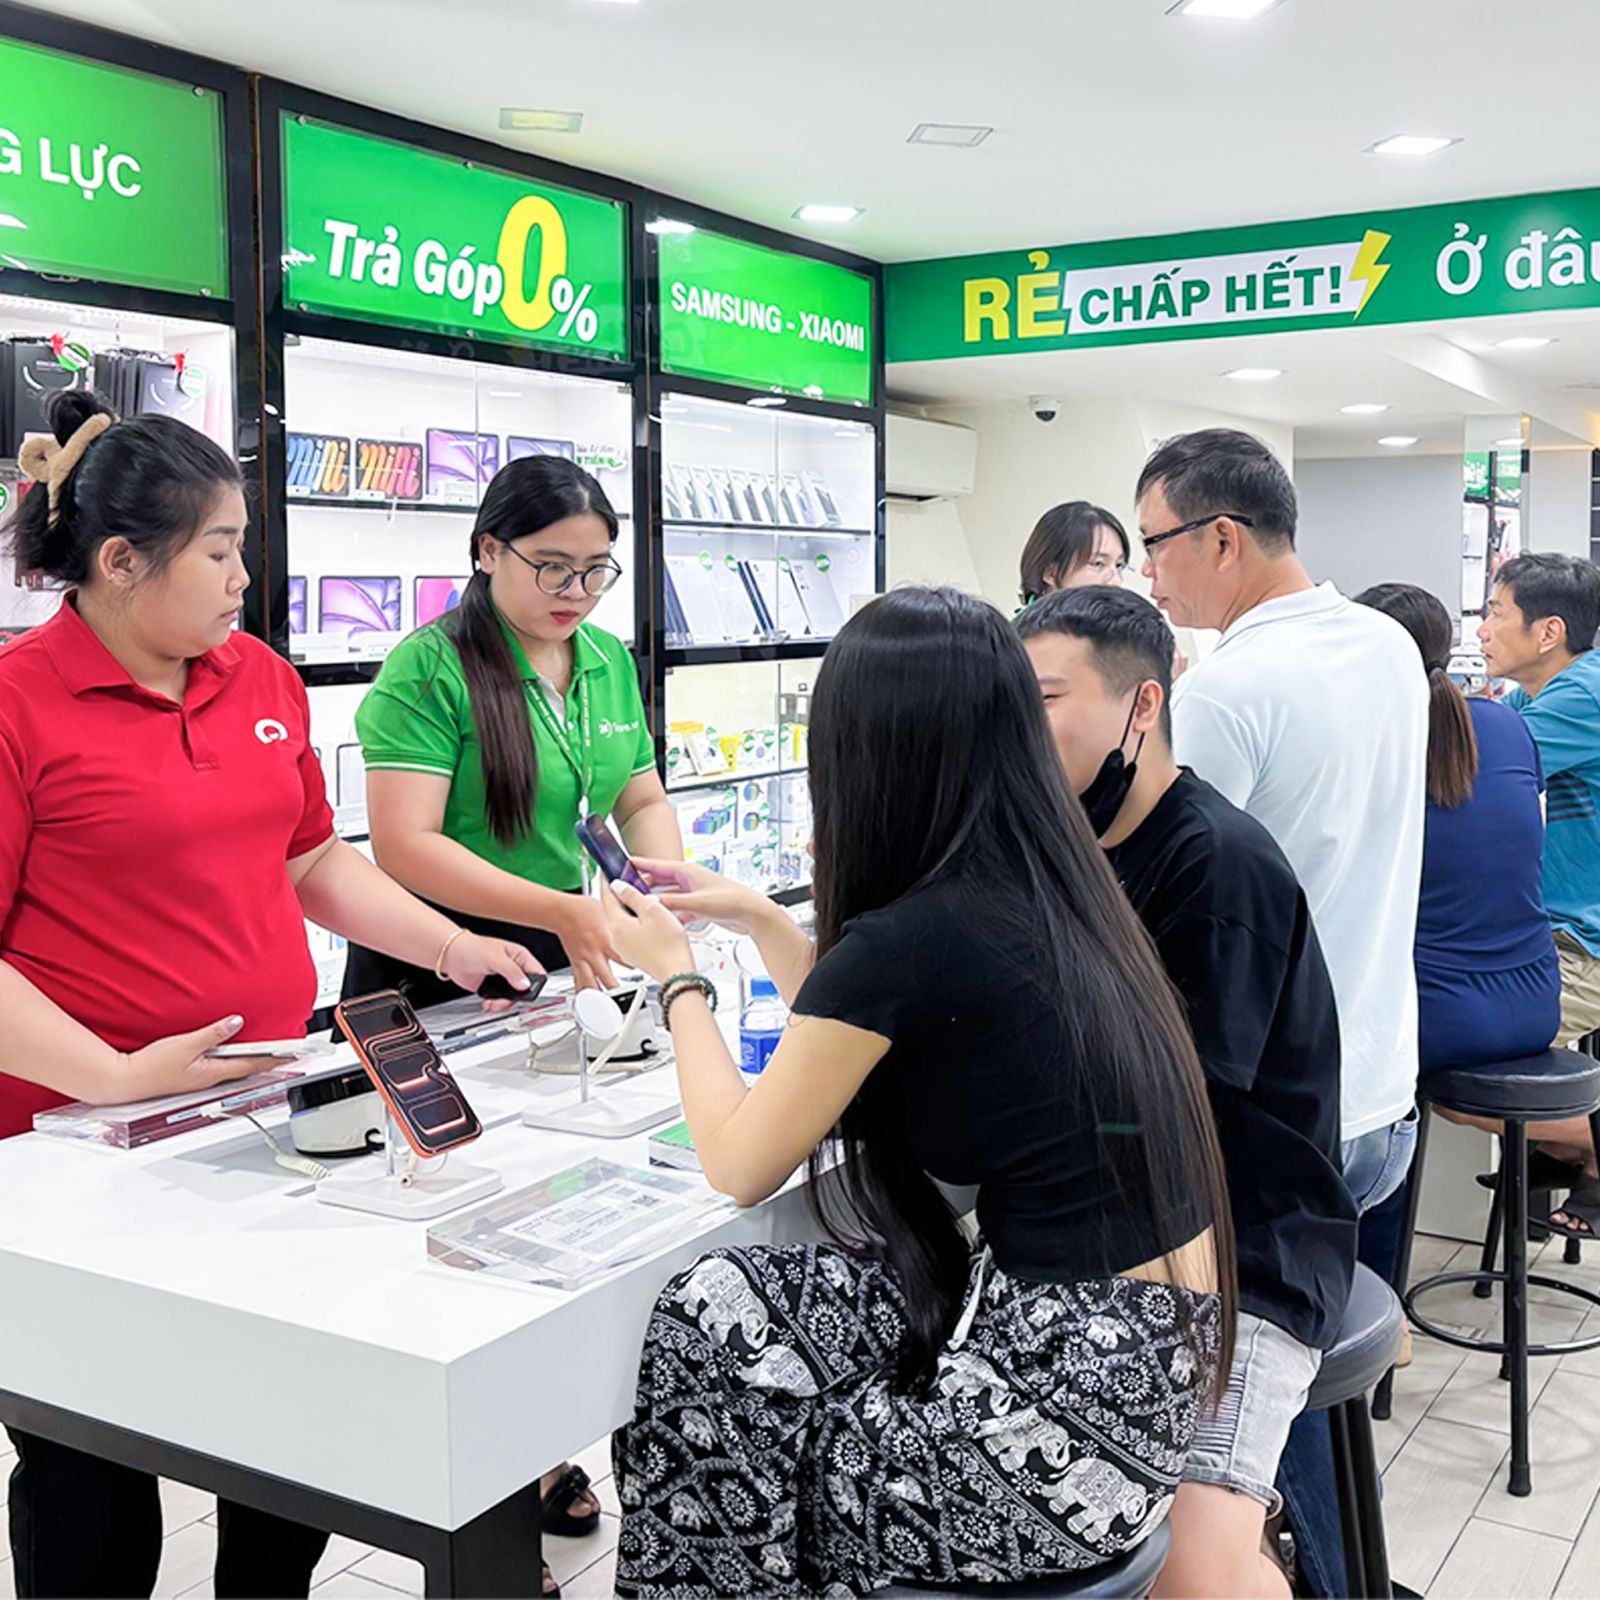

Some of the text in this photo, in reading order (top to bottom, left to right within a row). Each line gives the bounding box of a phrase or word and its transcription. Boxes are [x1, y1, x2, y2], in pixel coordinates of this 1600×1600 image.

[39, 136, 142, 201] LỰC
[324, 218, 402, 288] Trả
[413, 239, 503, 317] Góp
[1436, 222, 1488, 295] Ở
[671, 282, 865, 352] SAMSUNG - XIAOMI
[963, 249, 1341, 343] RẺ CHẤP HẾT!
